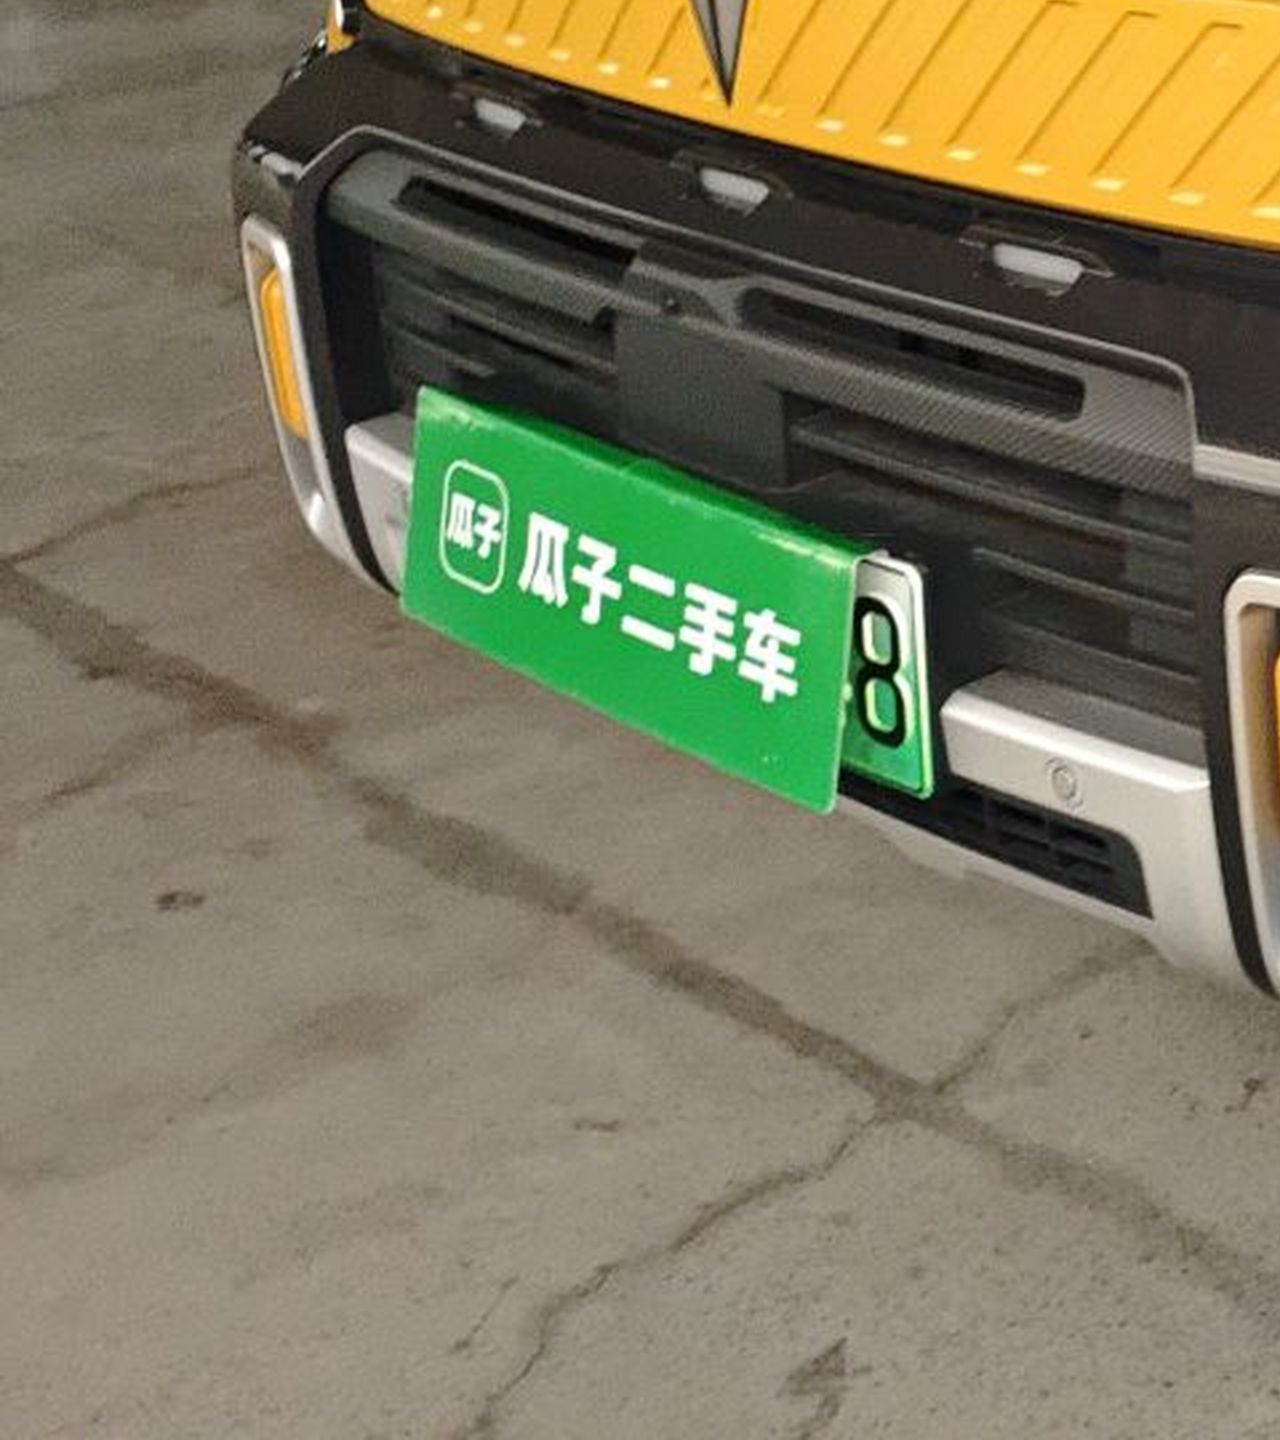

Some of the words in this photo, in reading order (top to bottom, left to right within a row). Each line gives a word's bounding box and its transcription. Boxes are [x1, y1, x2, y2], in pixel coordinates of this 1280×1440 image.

[446, 491, 502, 560] 瓜子
[518, 511, 801, 703] 瓜子二手车
[853, 596, 907, 748] 8
